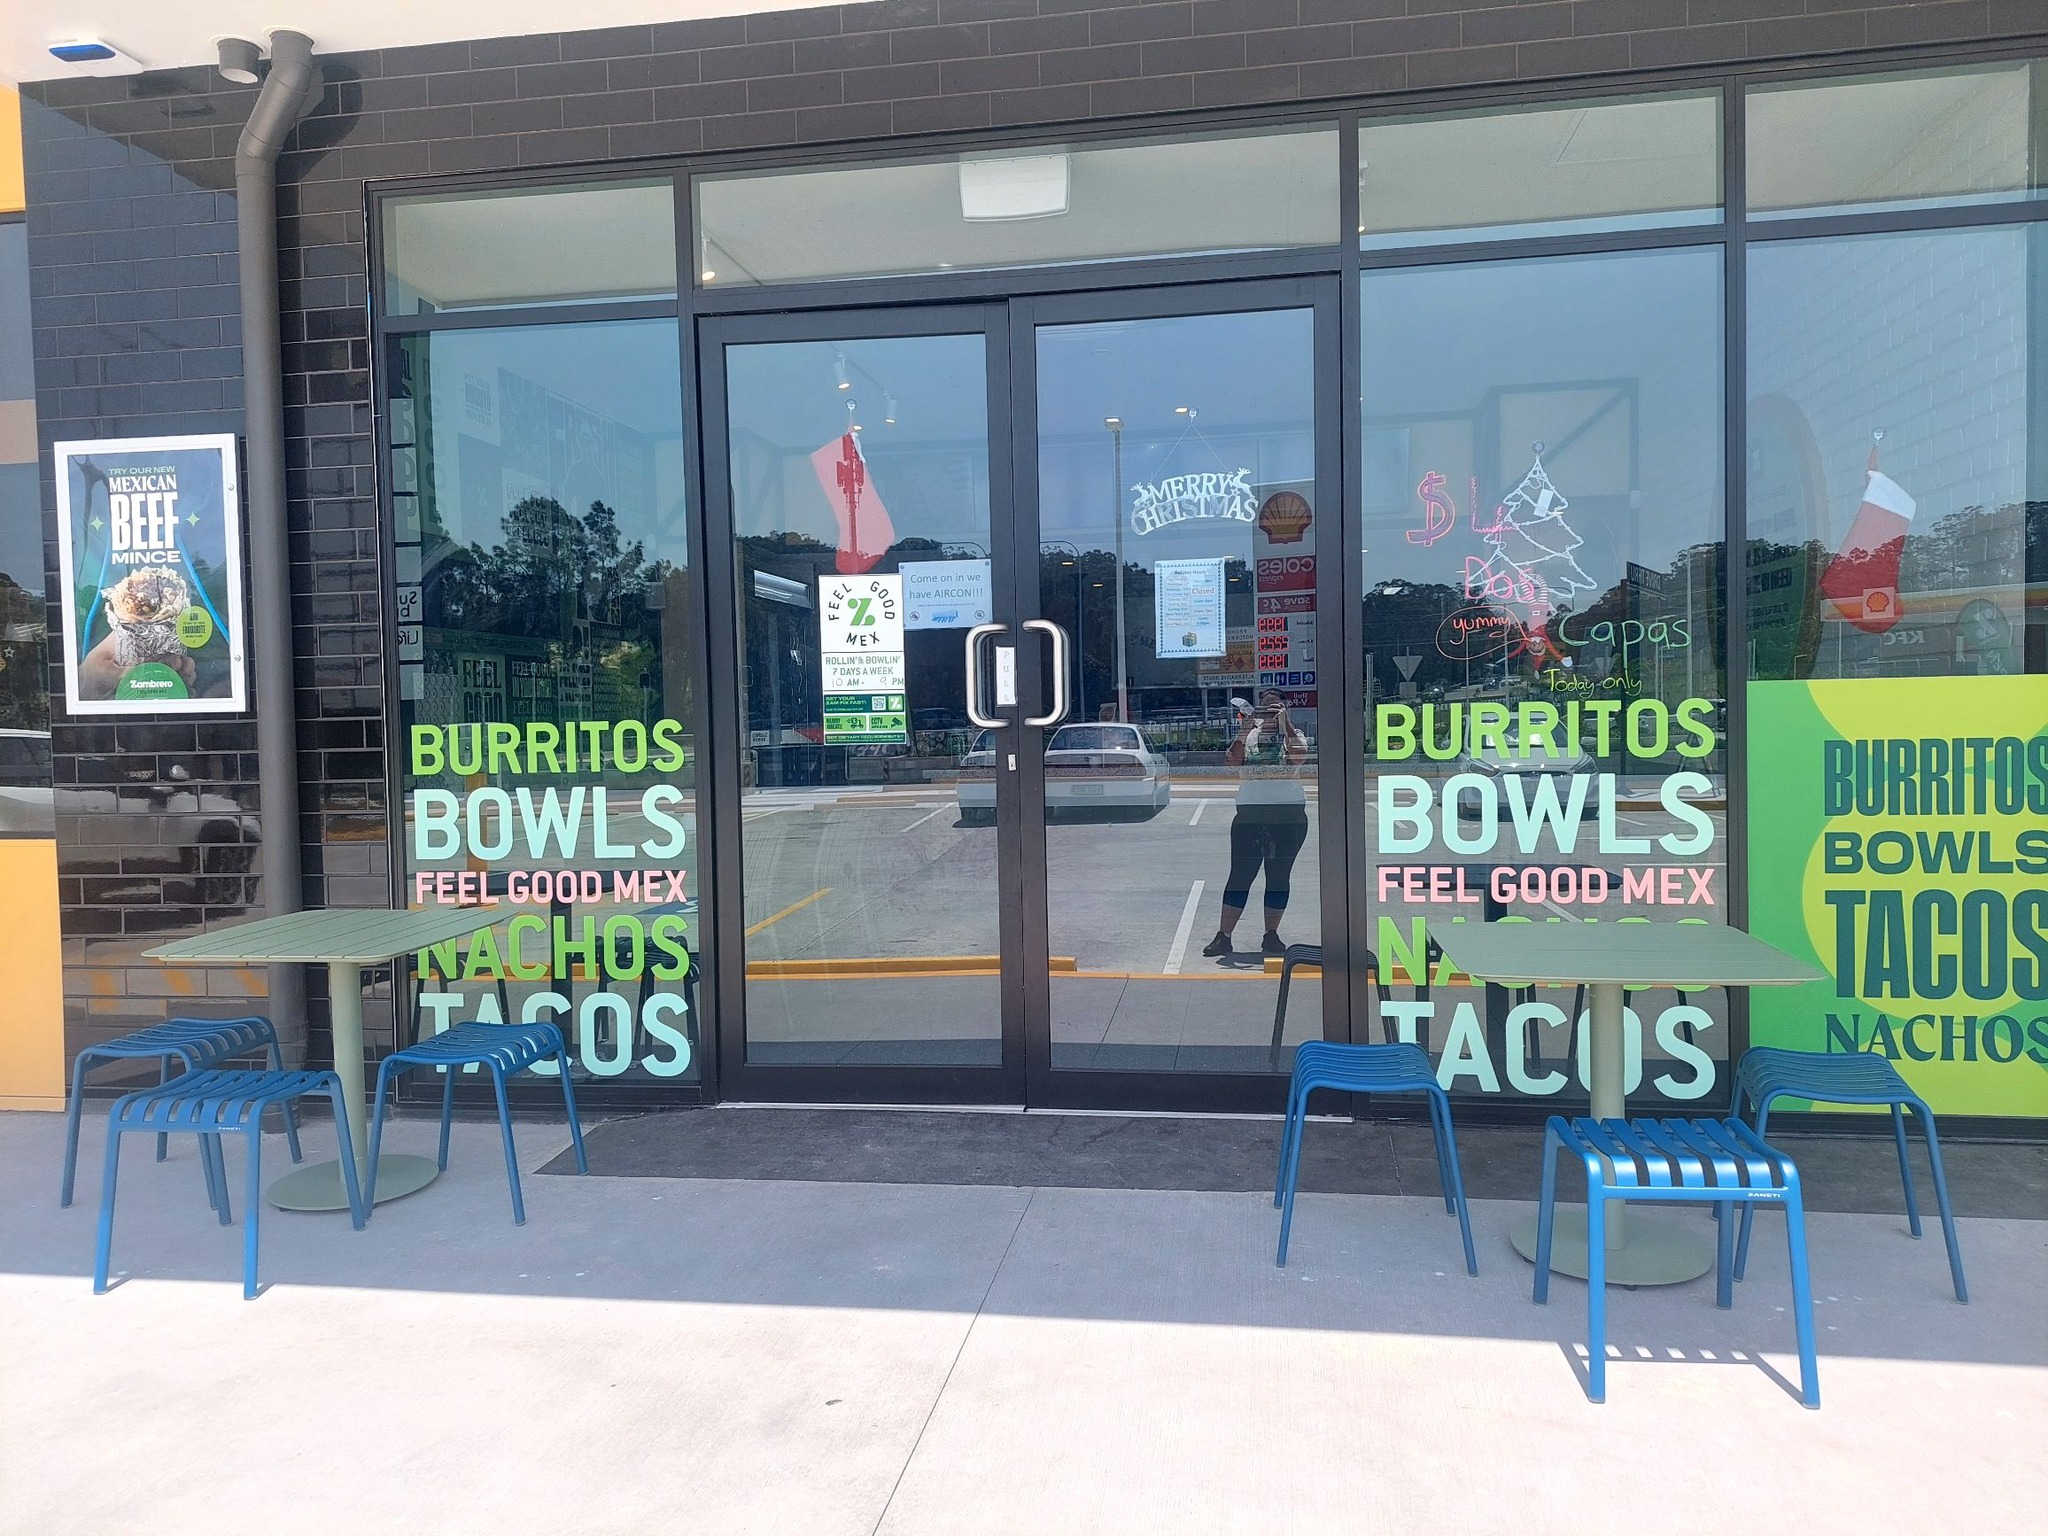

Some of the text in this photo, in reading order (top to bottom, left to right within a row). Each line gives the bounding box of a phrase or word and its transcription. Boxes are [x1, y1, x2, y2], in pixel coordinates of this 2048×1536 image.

[109, 474, 177, 492] MEXICAN
[1147, 472, 1233, 505] MERRY
[110, 491, 180, 551] BEEF
[1130, 495, 1259, 536] CHRISTMAS
[111, 550, 181, 565] MINCE
[909, 587, 983, 599] have AIRCON!!!
[910, 574, 938, 583] Come
[955, 573, 964, 582] in
[966, 573, 981, 581] we
[1191, 587, 1215, 595] Closed
[828, 581, 895, 621] FEEL GOOD
[846, 631, 880, 647] MEX
[1450, 616, 1511, 645] yummy
[1558, 610, 1692, 670] Capas
[825, 656, 858, 665] ROLLIN'
[865, 656, 900, 664] BOWLIN'
[832, 666, 894, 676] 7 DAYS A WEEK
[129, 679, 174, 689] Zambrero
[891, 677, 904, 686] PM
[1543, 669, 1642, 699] Today only
[1376, 698, 1716, 760] BURRITOS
[411, 719, 685, 776] BURRITOS
[1824, 736, 2048, 817] BURRITOS
[413, 785, 687, 860] BOWLS
[1377, 772, 1716, 856] BOWLS
[1824, 830, 2048, 875] BOWLS
[415, 870, 687, 904] FEEL GOOD MEX
[1377, 866, 1716, 905] FEEL GOOD MEX
[1824, 888, 2048, 1001] TACOS
[1825, 1013, 2048, 1064] NACHOS
